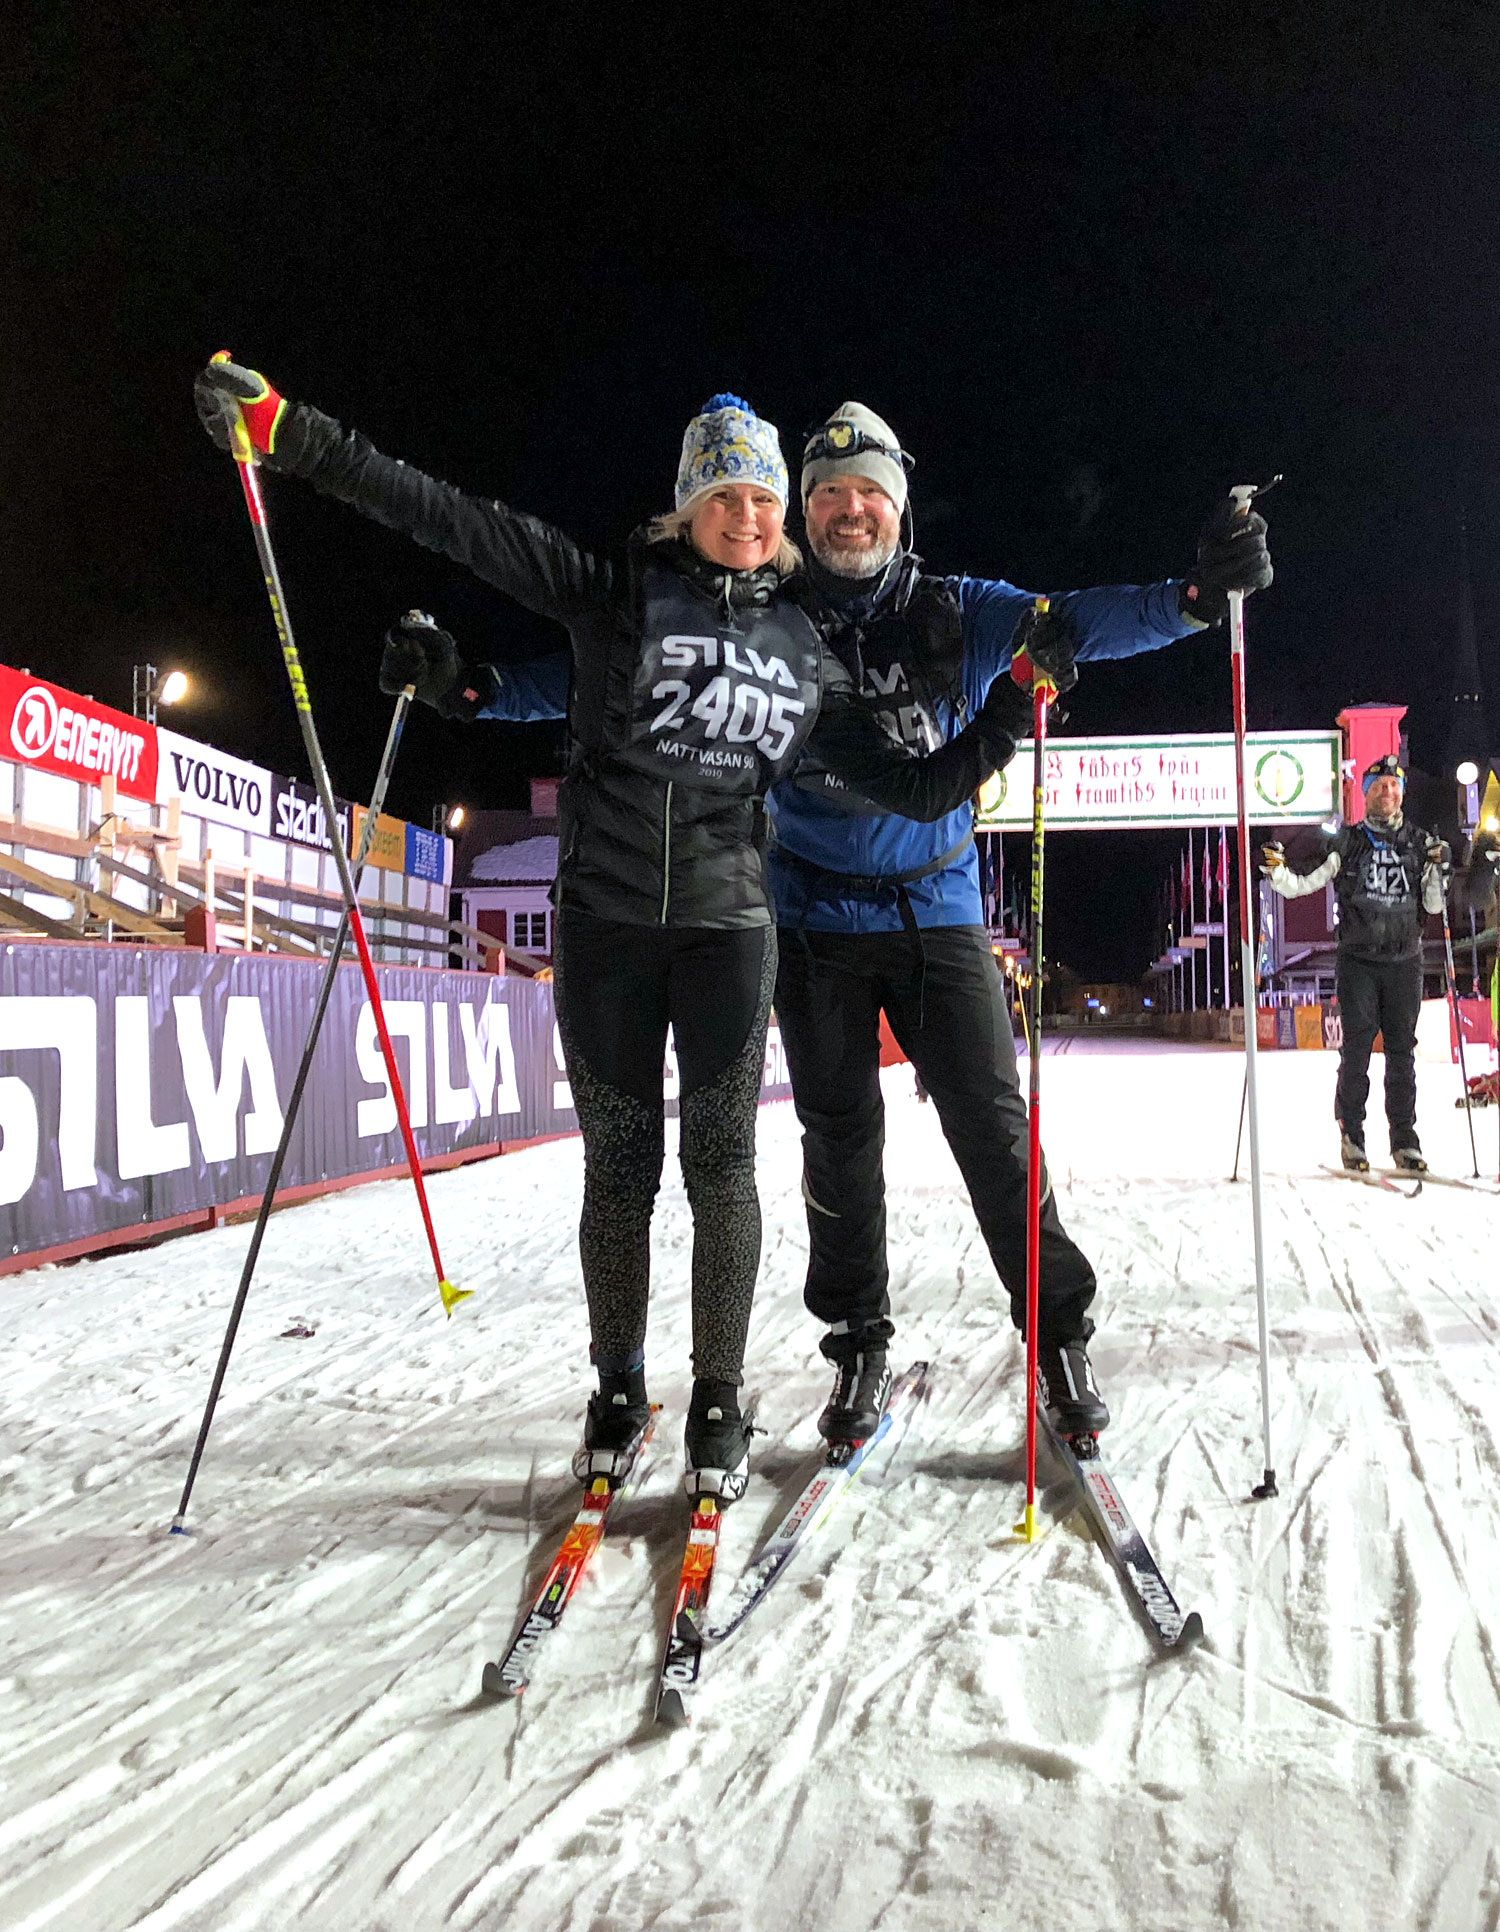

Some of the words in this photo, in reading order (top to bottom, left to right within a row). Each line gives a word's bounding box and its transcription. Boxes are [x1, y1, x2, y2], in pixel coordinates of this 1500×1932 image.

[661, 635, 799, 690] SILVA
[54, 706, 145, 782] ENERVIT
[650, 676, 806, 762] 2405
[170, 751, 262, 817] VOLVO
[655, 739, 742, 768] NATTVASAN
[743, 754, 755, 770] 90
[697, 767, 723, 780] 2019
[354, 999, 521, 1138] SILVA
